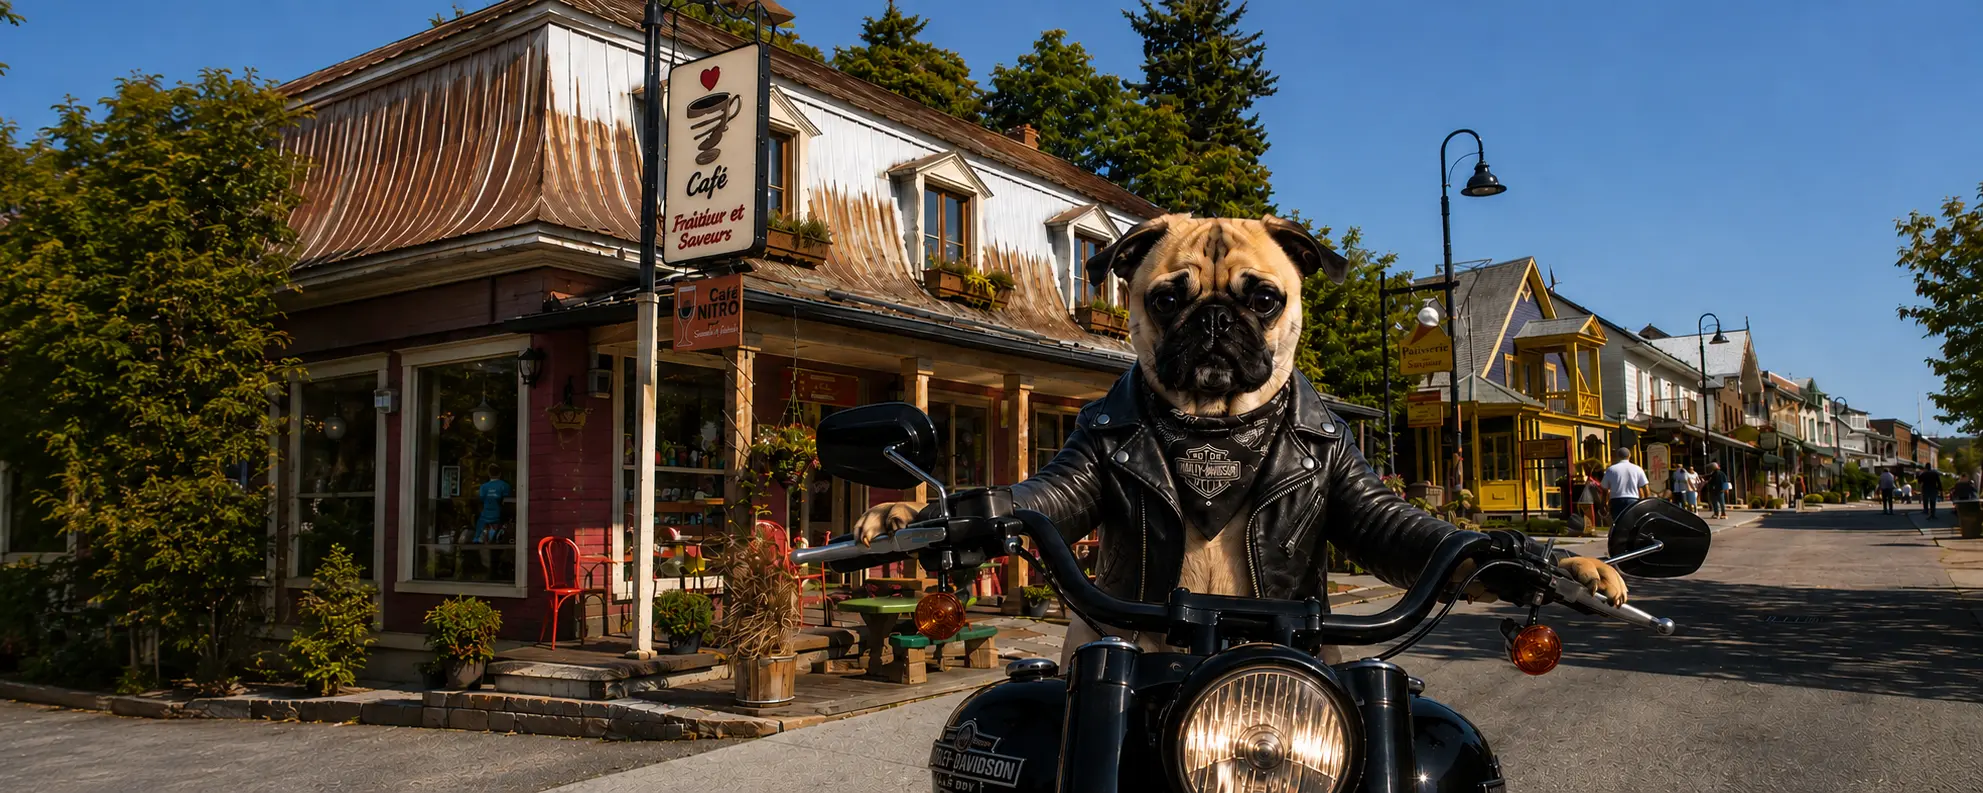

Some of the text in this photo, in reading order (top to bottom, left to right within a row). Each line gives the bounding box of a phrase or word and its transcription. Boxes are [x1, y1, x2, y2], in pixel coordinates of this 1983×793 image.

[686, 165, 728, 199] Café
[730, 204, 745, 222] et
[678, 229, 732, 250] Saveurs
[709, 284, 738, 302] Café
[698, 300, 739, 321] NITRO
